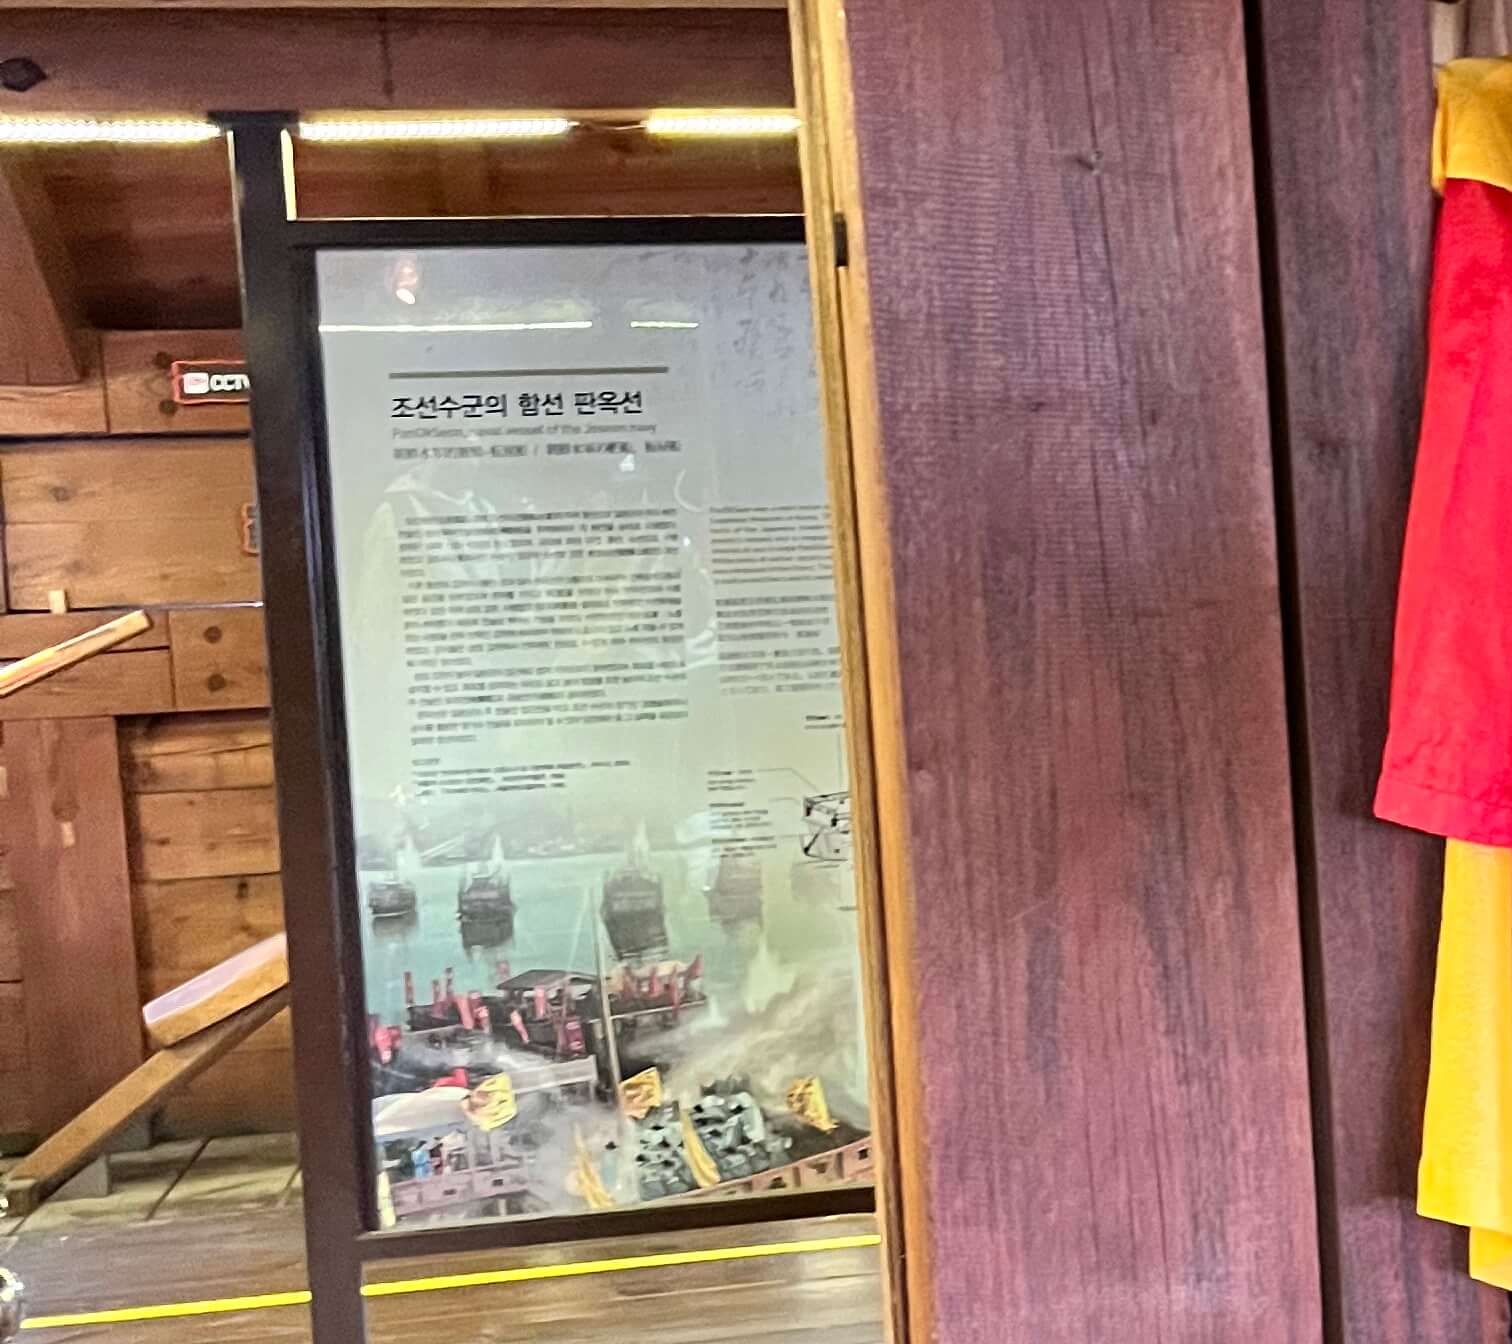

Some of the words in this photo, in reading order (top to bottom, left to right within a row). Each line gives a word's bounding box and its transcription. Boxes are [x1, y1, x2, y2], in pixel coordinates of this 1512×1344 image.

[391, 394, 508, 419] 조선수군의
[518, 392, 565, 417] 함선
[574, 390, 644, 415] 판옥선
